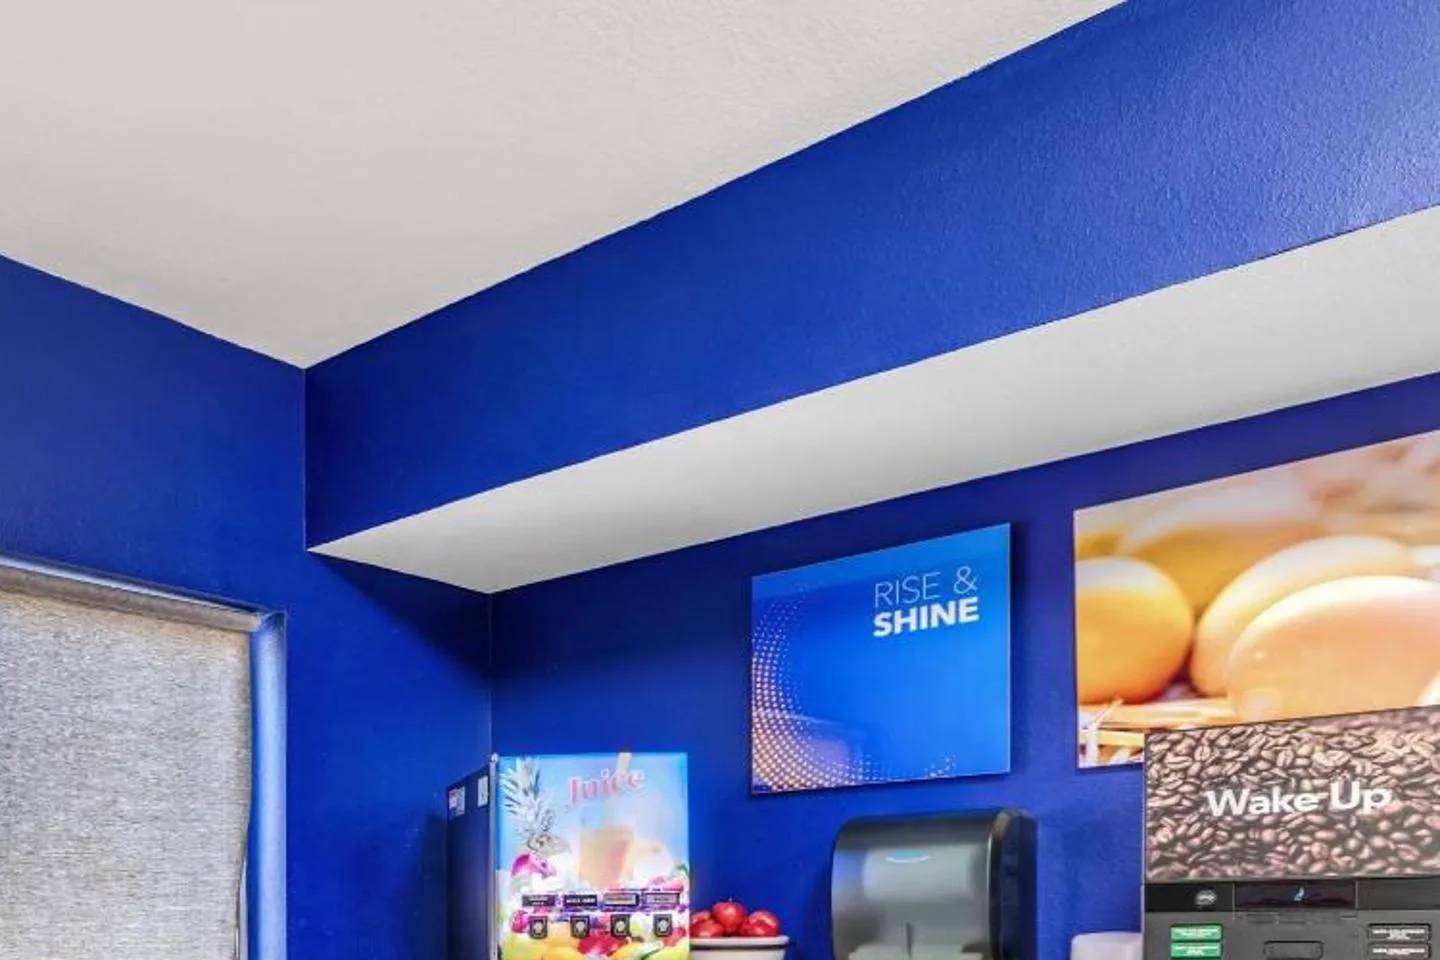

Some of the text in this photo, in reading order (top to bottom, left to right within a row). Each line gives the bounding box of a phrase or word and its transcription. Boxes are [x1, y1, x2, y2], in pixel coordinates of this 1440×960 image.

[874, 565, 978, 608] RISE &
[872, 596, 980, 637] SHINE
[564, 767, 647, 810] Juice
[1205, 780, 1392, 817] Wake Up
